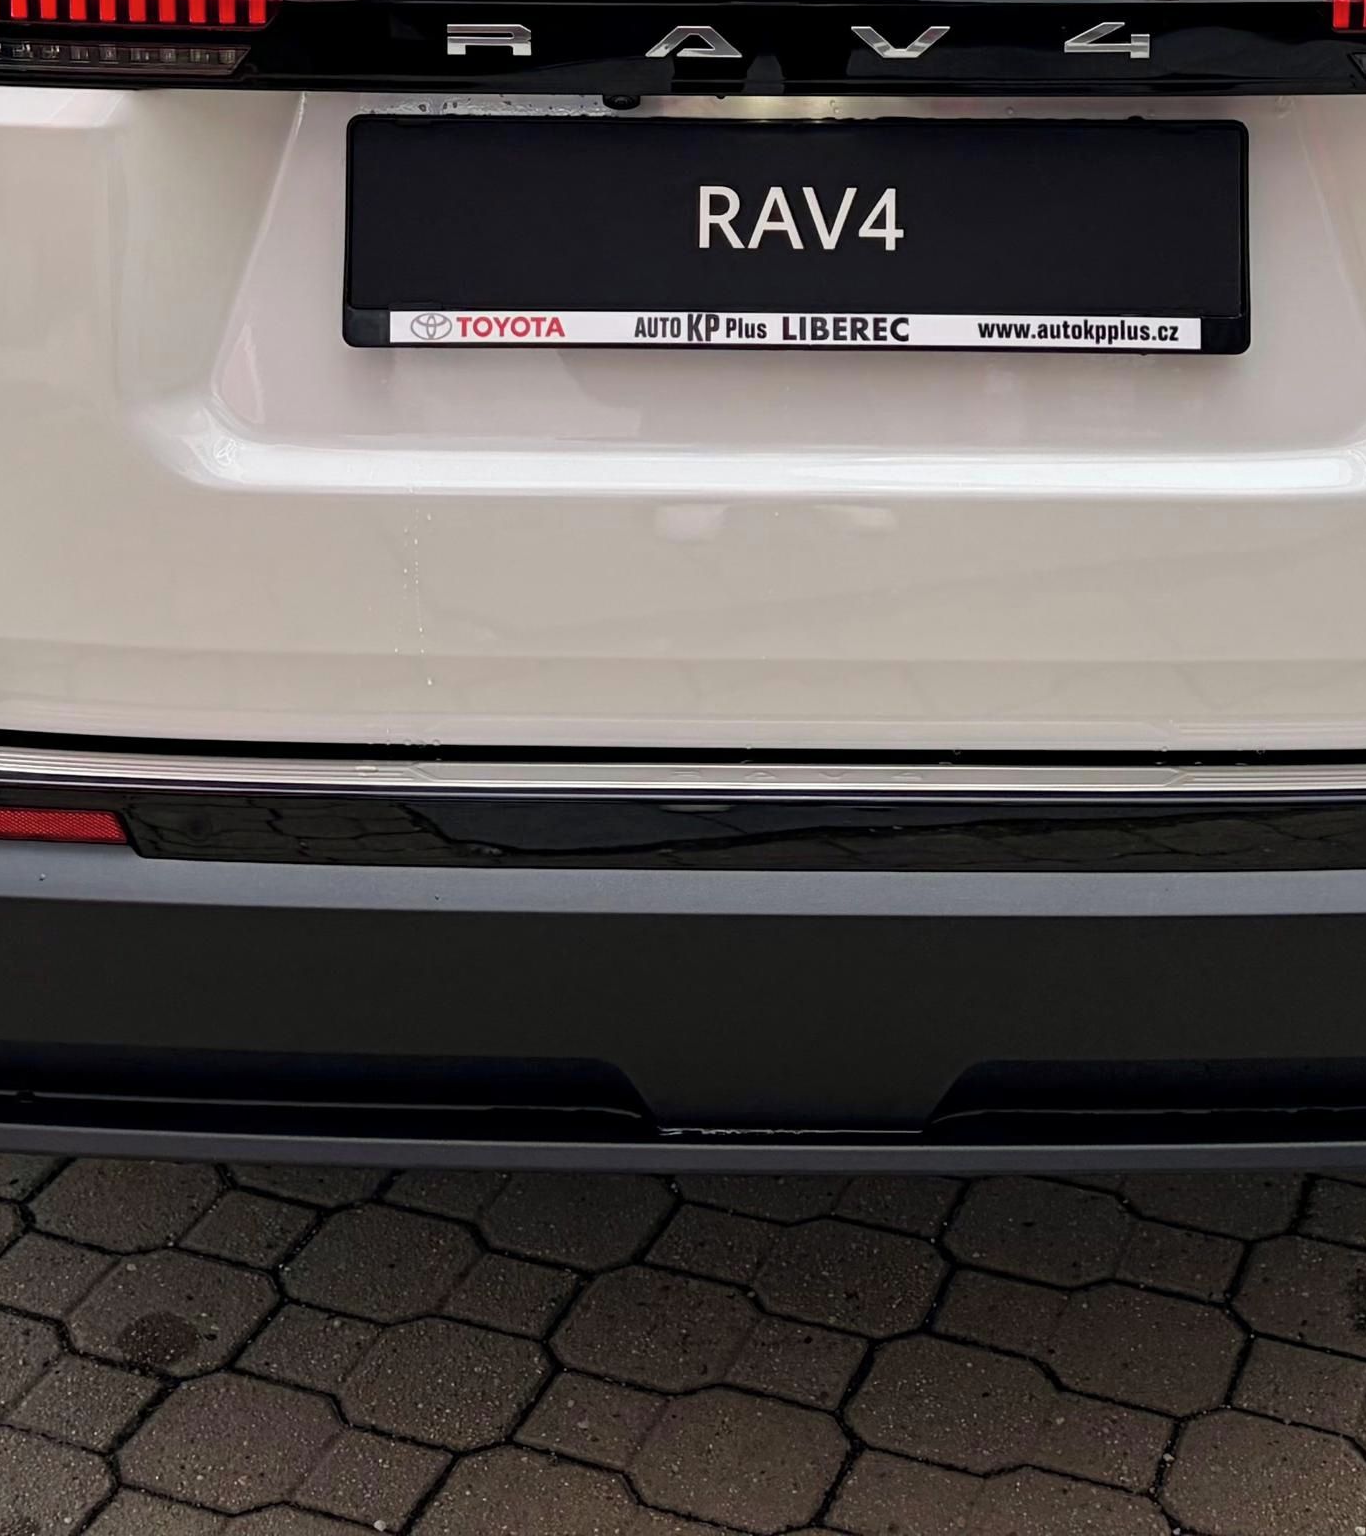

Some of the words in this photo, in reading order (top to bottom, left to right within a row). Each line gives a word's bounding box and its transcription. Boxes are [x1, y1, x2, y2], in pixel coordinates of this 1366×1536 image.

[447, 21, 1150, 58] RAV4
[698, 185, 904, 251] RAV4
[456, 316, 565, 339] TOYOTA
[634, 316, 681, 340] AUTO
[687, 313, 721, 342] KP
[726, 318, 767, 340] Plus
[782, 317, 910, 342] LIBEREC
[978, 319, 1179, 345] www.autokpplus.cz
